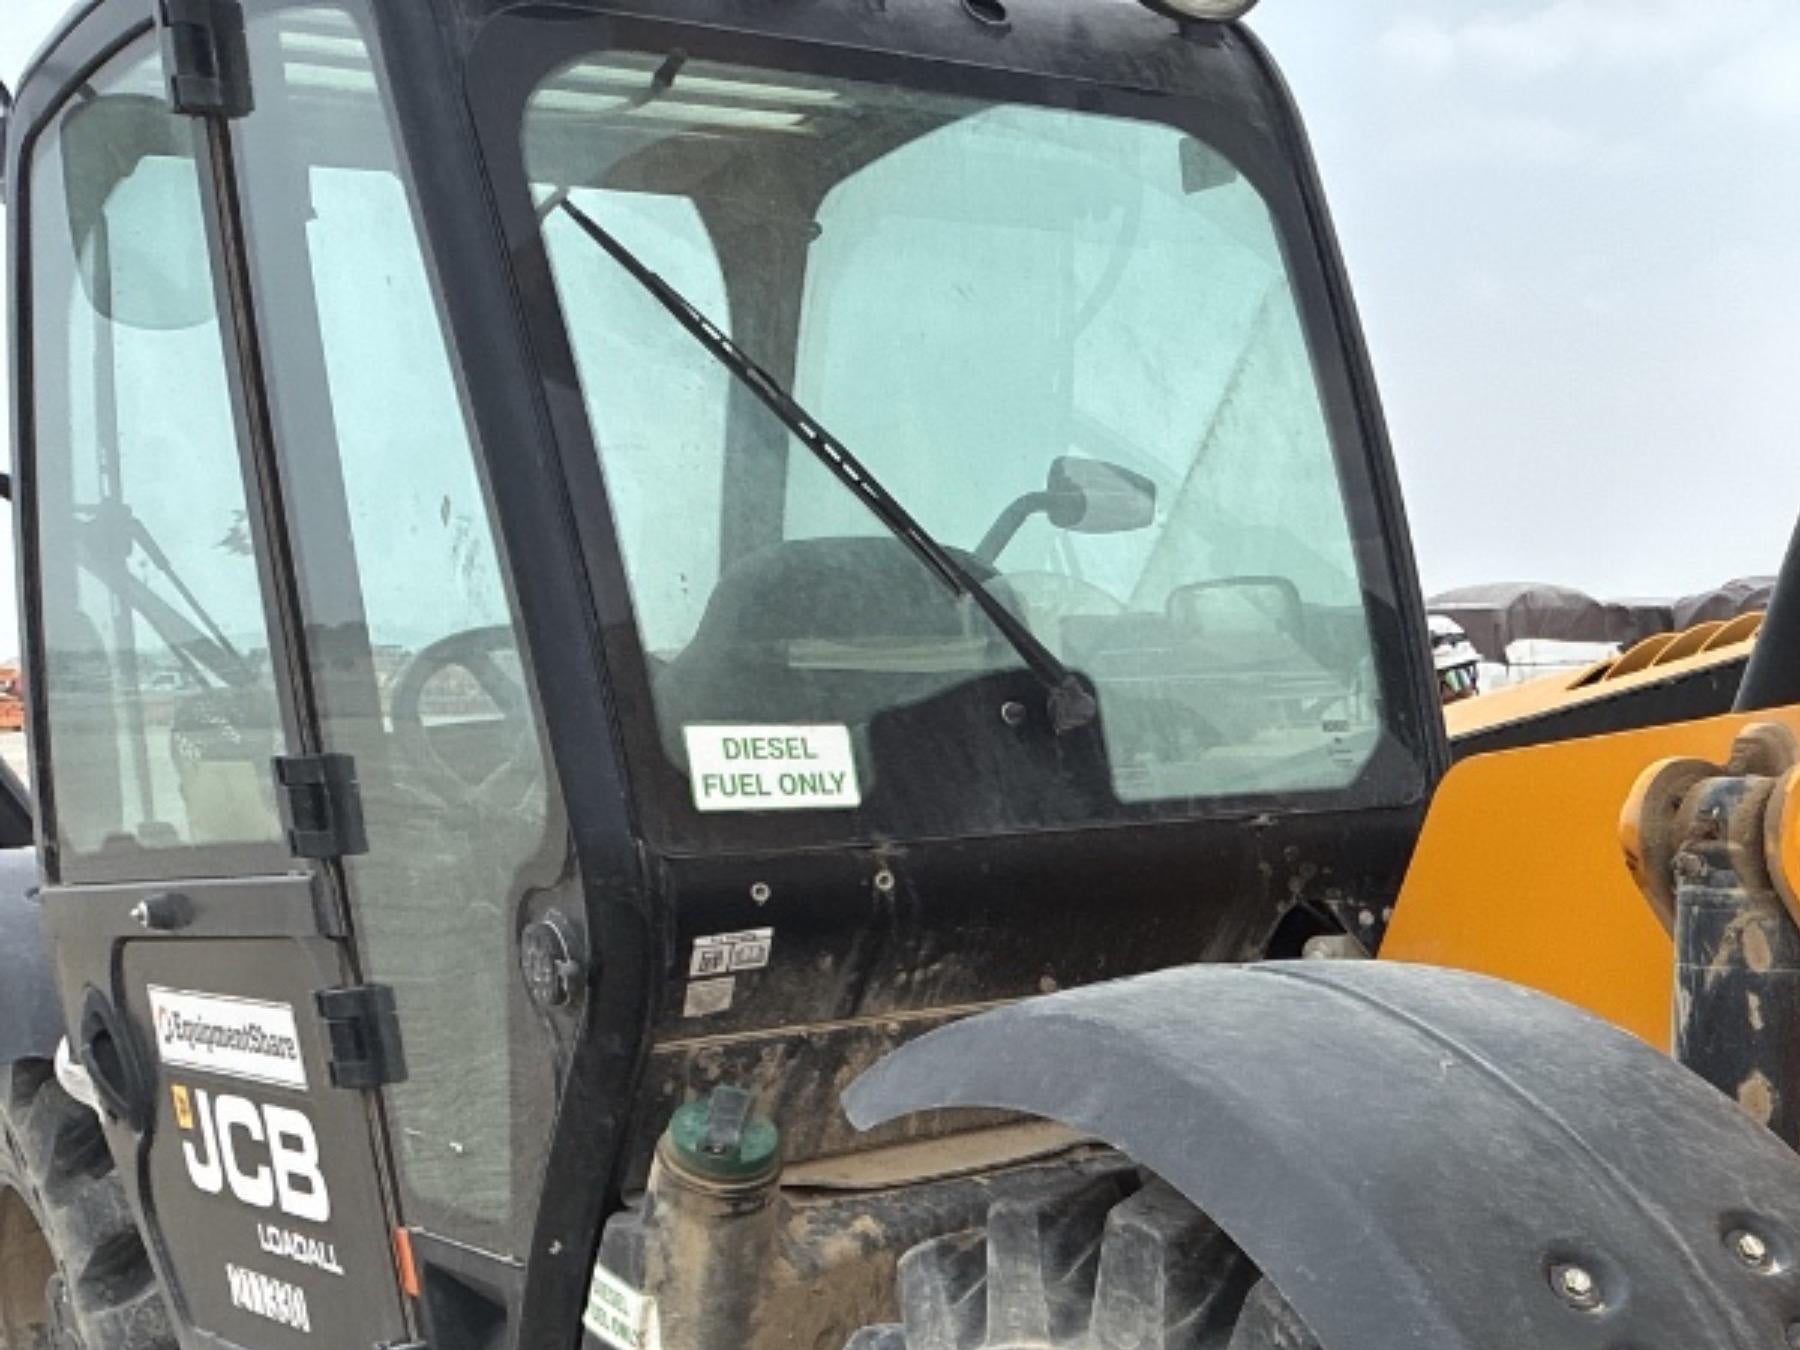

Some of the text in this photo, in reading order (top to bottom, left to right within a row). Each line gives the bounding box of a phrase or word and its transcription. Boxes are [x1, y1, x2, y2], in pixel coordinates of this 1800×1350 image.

[722, 736, 820, 761] DIESEL
[701, 770, 847, 798] FUEL ONLY
[182, 1087, 332, 1223] JCB
[256, 1222, 346, 1276] LOADALL
